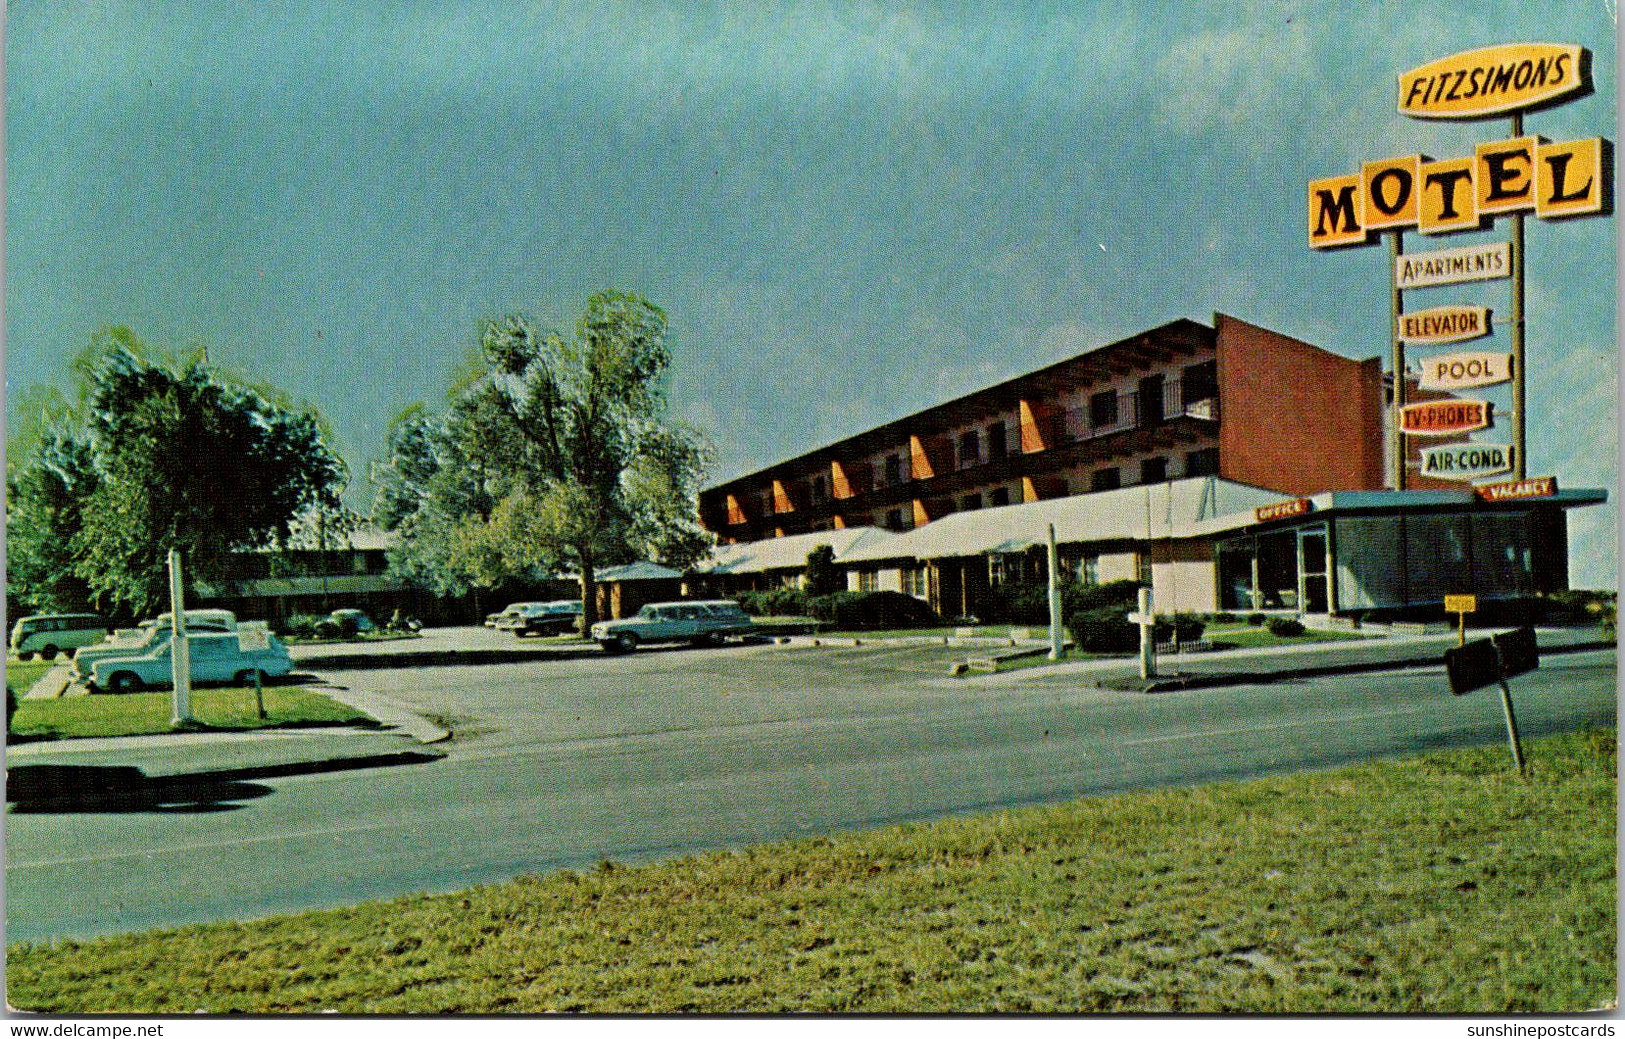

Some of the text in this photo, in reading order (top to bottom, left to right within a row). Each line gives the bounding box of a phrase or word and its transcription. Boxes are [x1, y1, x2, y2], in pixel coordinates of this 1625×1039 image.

[1406, 52, 1570, 107] FITZSIMONS
[1312, 148, 1593, 236] MOTEL
[1403, 253, 1503, 282] APARTMENTS
[1406, 312, 1478, 336] ELEVATOR
[1438, 359, 1493, 380] POOL
[1490, 481, 1549, 499] VACANCY
[1259, 502, 1301, 519] OFFICE
